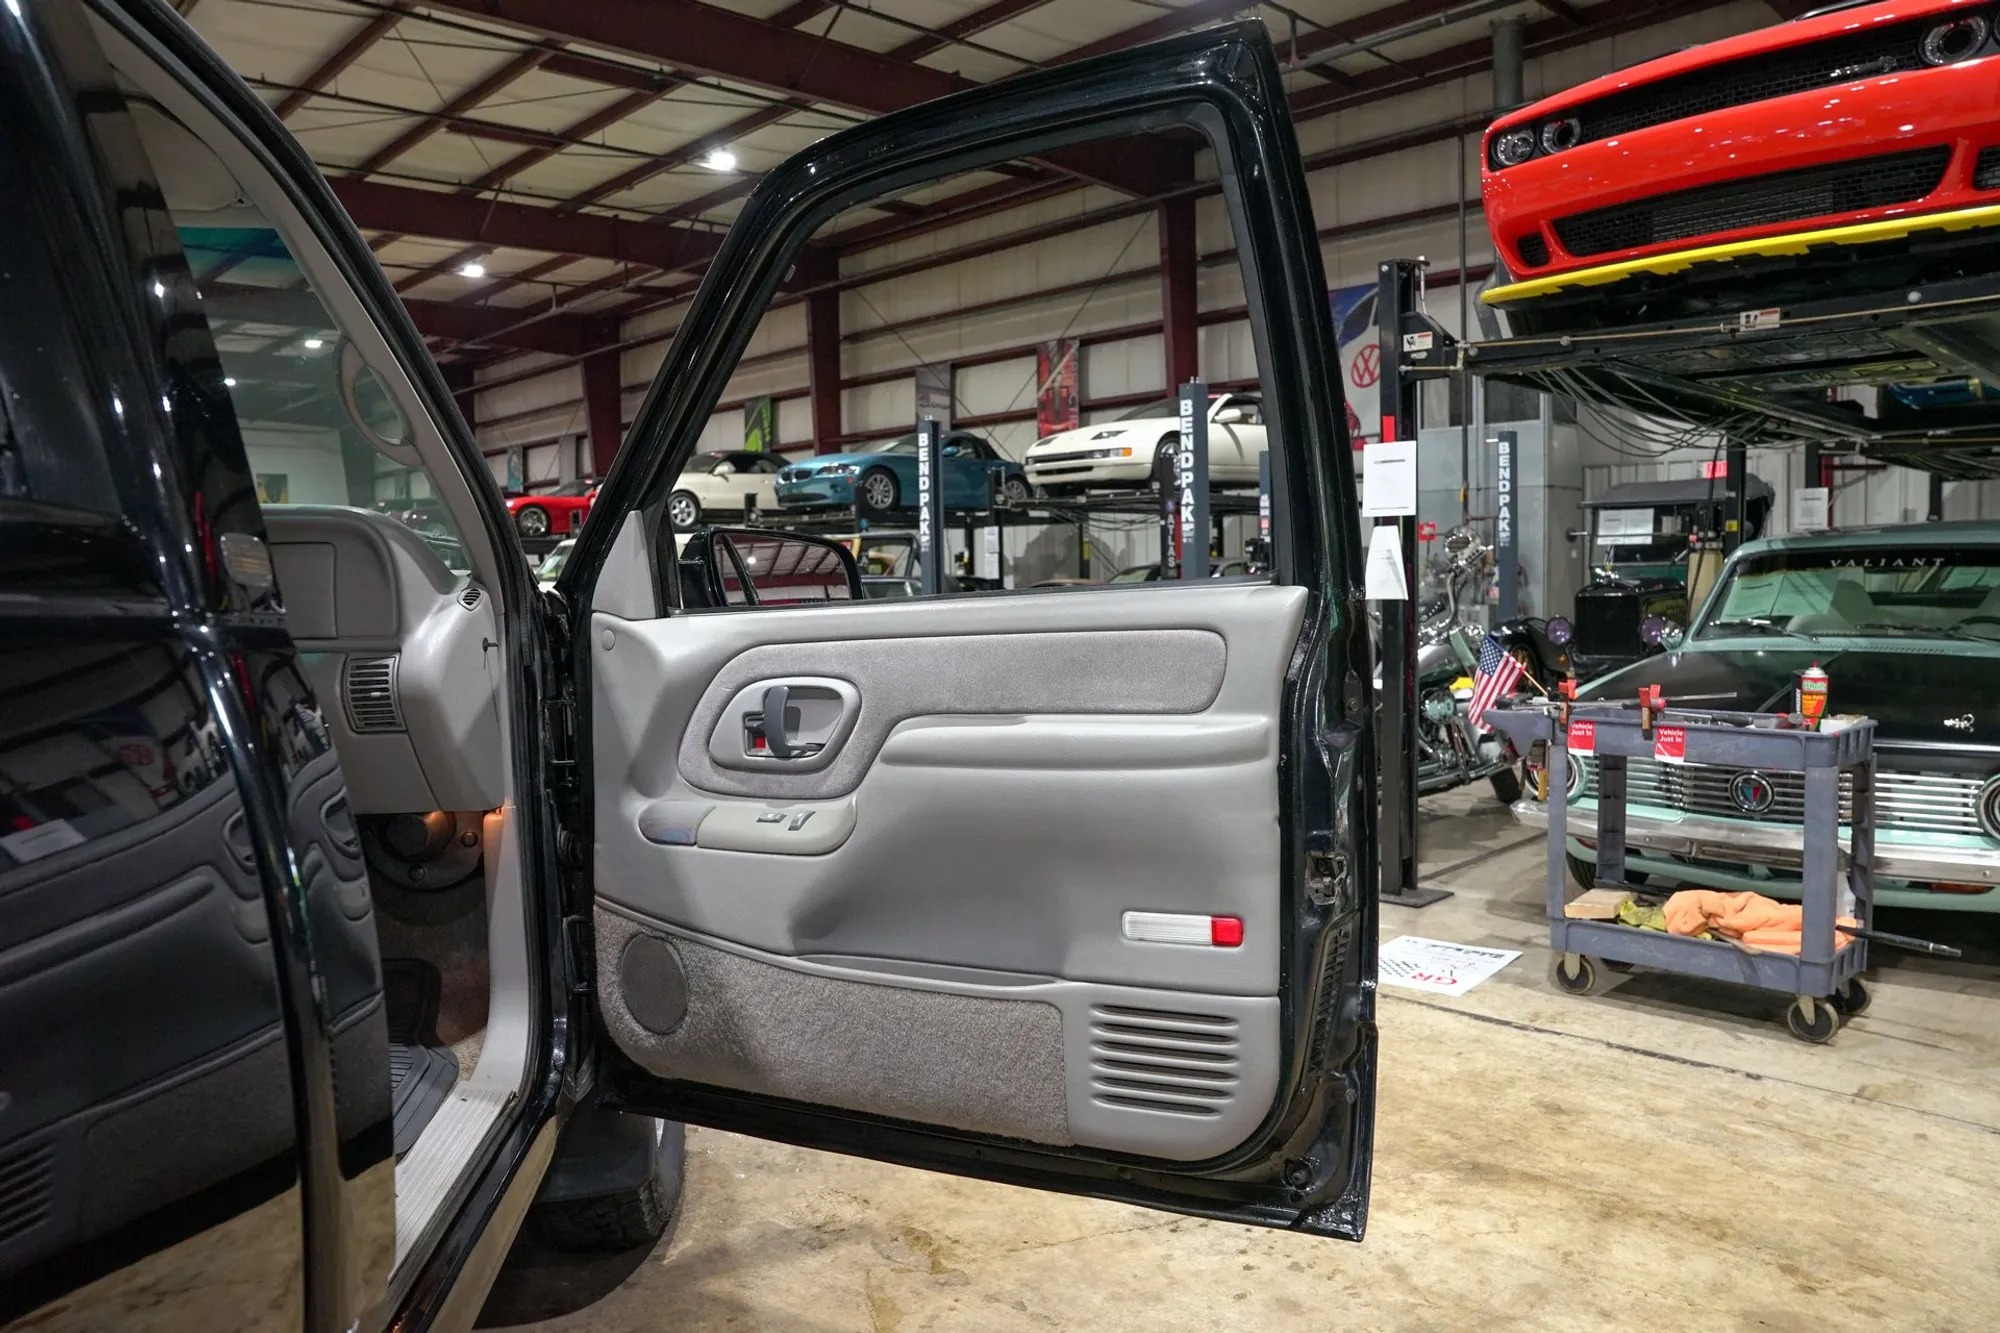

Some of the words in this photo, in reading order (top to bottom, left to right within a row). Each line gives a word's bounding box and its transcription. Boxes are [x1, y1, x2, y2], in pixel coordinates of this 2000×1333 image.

[918, 432, 930, 534] BENDPAK
[1180, 399, 1195, 522] BENDPAK
[1498, 441, 1510, 532] BENDPAK
[1167, 513, 1176, 568] ATLAS
[1830, 558, 1946, 567] VALIANT
[1659, 728, 1684, 736] Vehicle
